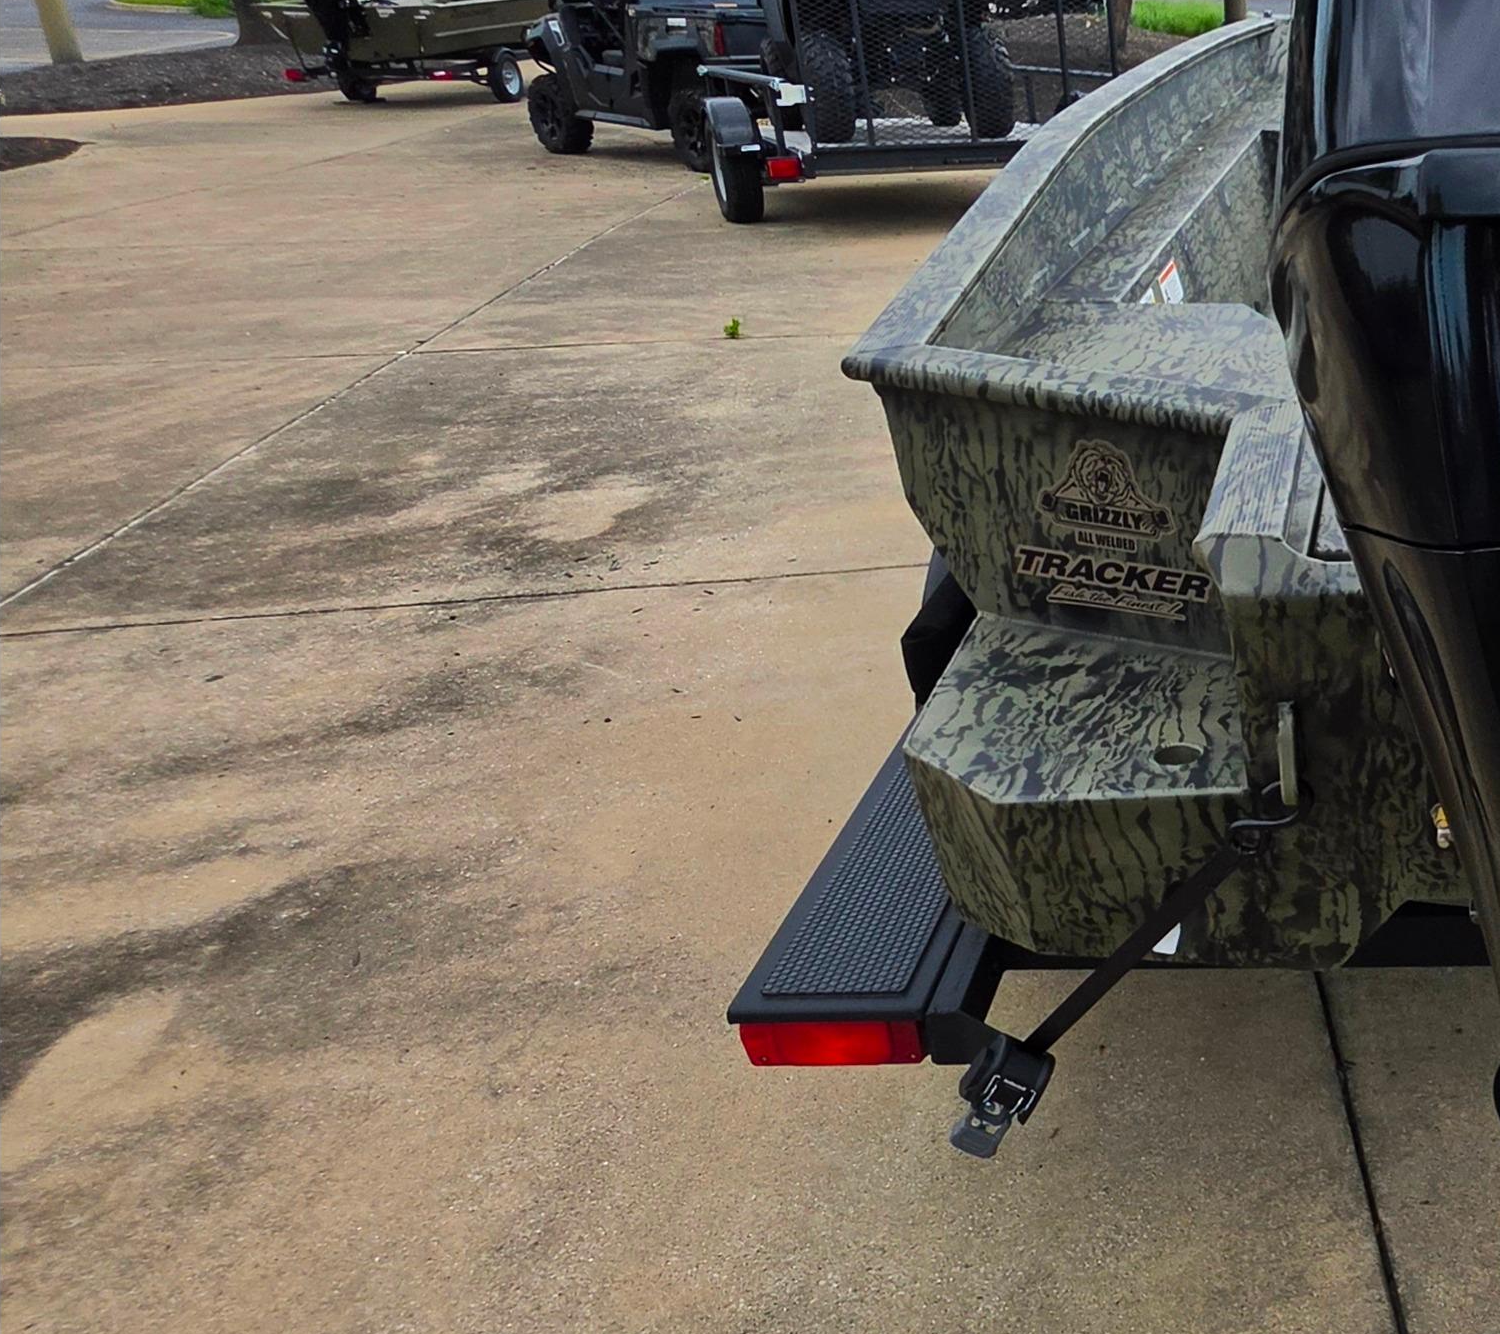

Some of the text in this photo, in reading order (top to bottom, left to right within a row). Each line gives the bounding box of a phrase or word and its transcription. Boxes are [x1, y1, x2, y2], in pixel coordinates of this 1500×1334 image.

[1065, 503, 1144, 531] GRIZZLY
[1077, 530, 1135, 551] ALL WELDED
[1018, 548, 1211, 599] TRACKER
